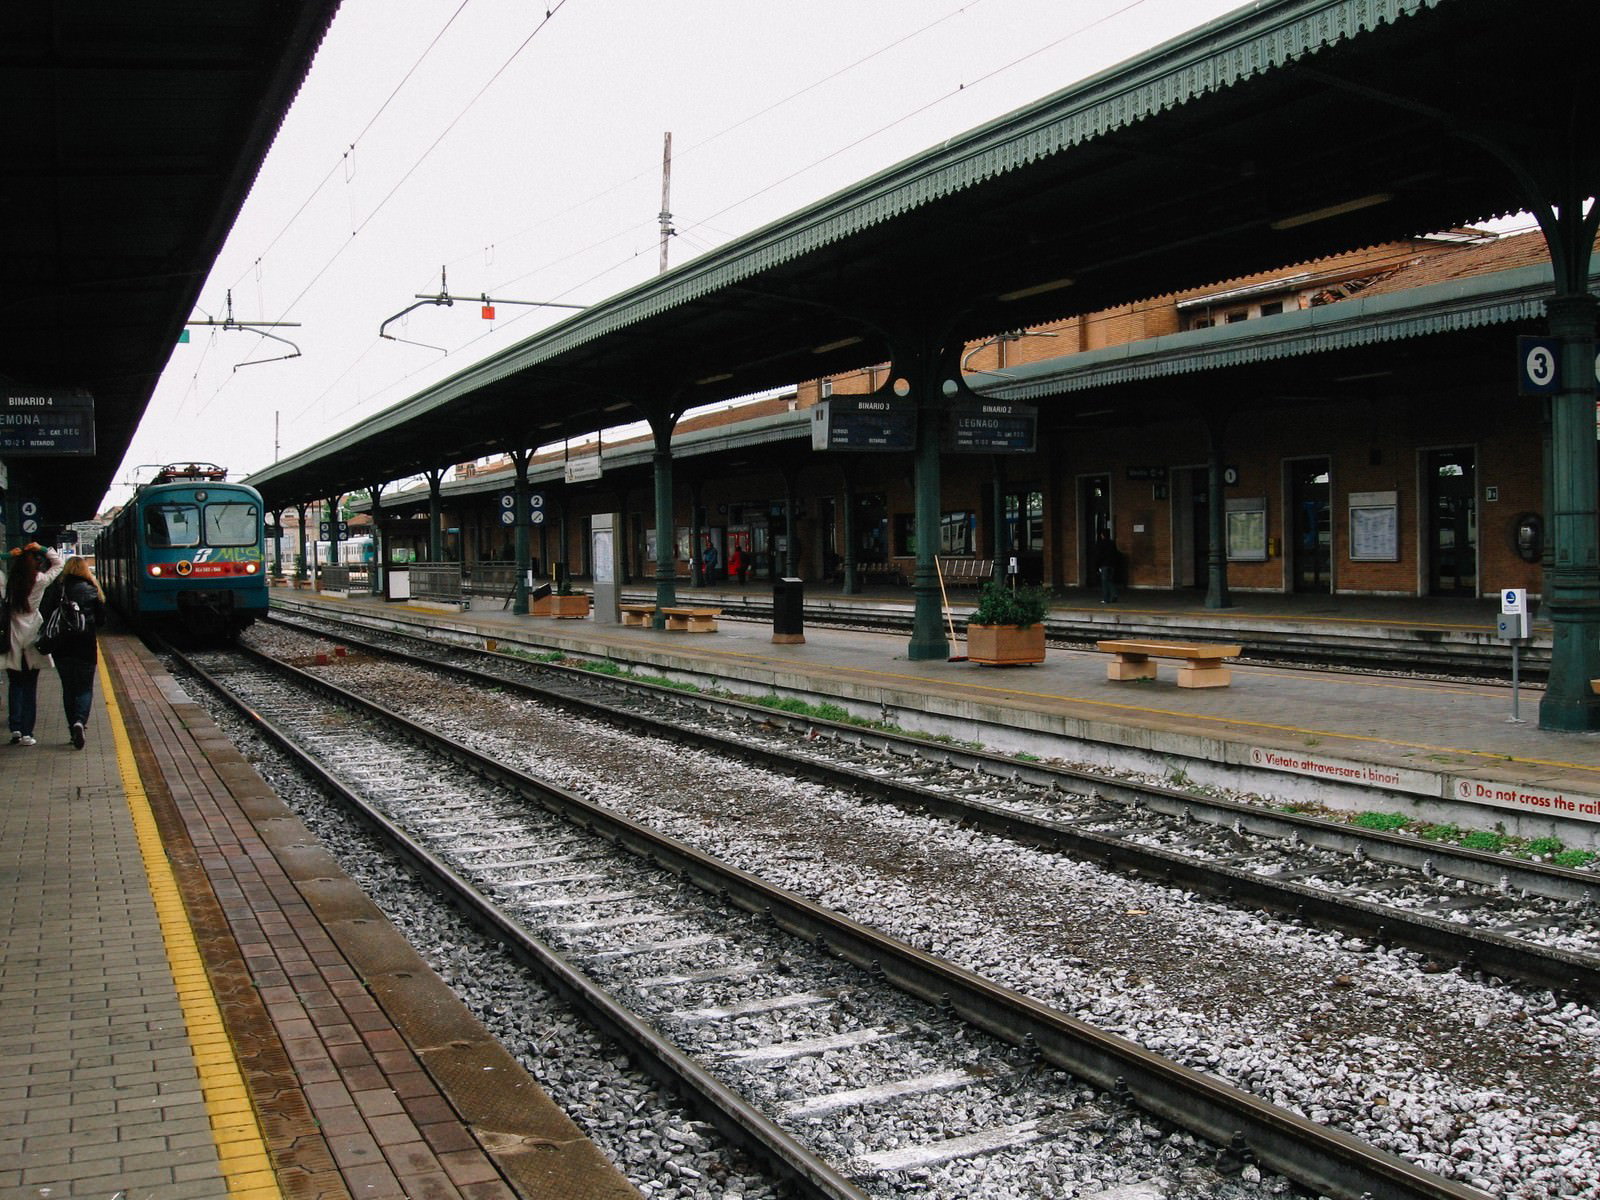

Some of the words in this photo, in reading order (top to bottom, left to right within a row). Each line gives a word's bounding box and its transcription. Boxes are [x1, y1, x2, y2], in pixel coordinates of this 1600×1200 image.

[1533, 352, 1549, 379] 3
[9, 397, 45, 406] BINARIO
[47, 397, 53, 406] 4
[858, 402, 885, 410] BINARIO
[885, 403, 891, 411] 3
[982, 405, 1007, 413] BINARIO
[1007, 406, 1013, 414] 2
[959, 418, 999, 429] LEGNAGO
[504, 498, 511, 506] 3
[25, 504, 32, 513] 4
[1266, 753, 1298, 768] Vietato
[1301, 761, 1360, 778] attraversare
[1362, 768, 1366, 780] i
[1368, 767, 1399, 785] binari
[1476, 784, 1492, 798] Do
[1496, 790, 1517, 802] not
[1520, 794, 1550, 808] cross
[1554, 795, 1575, 812] the
